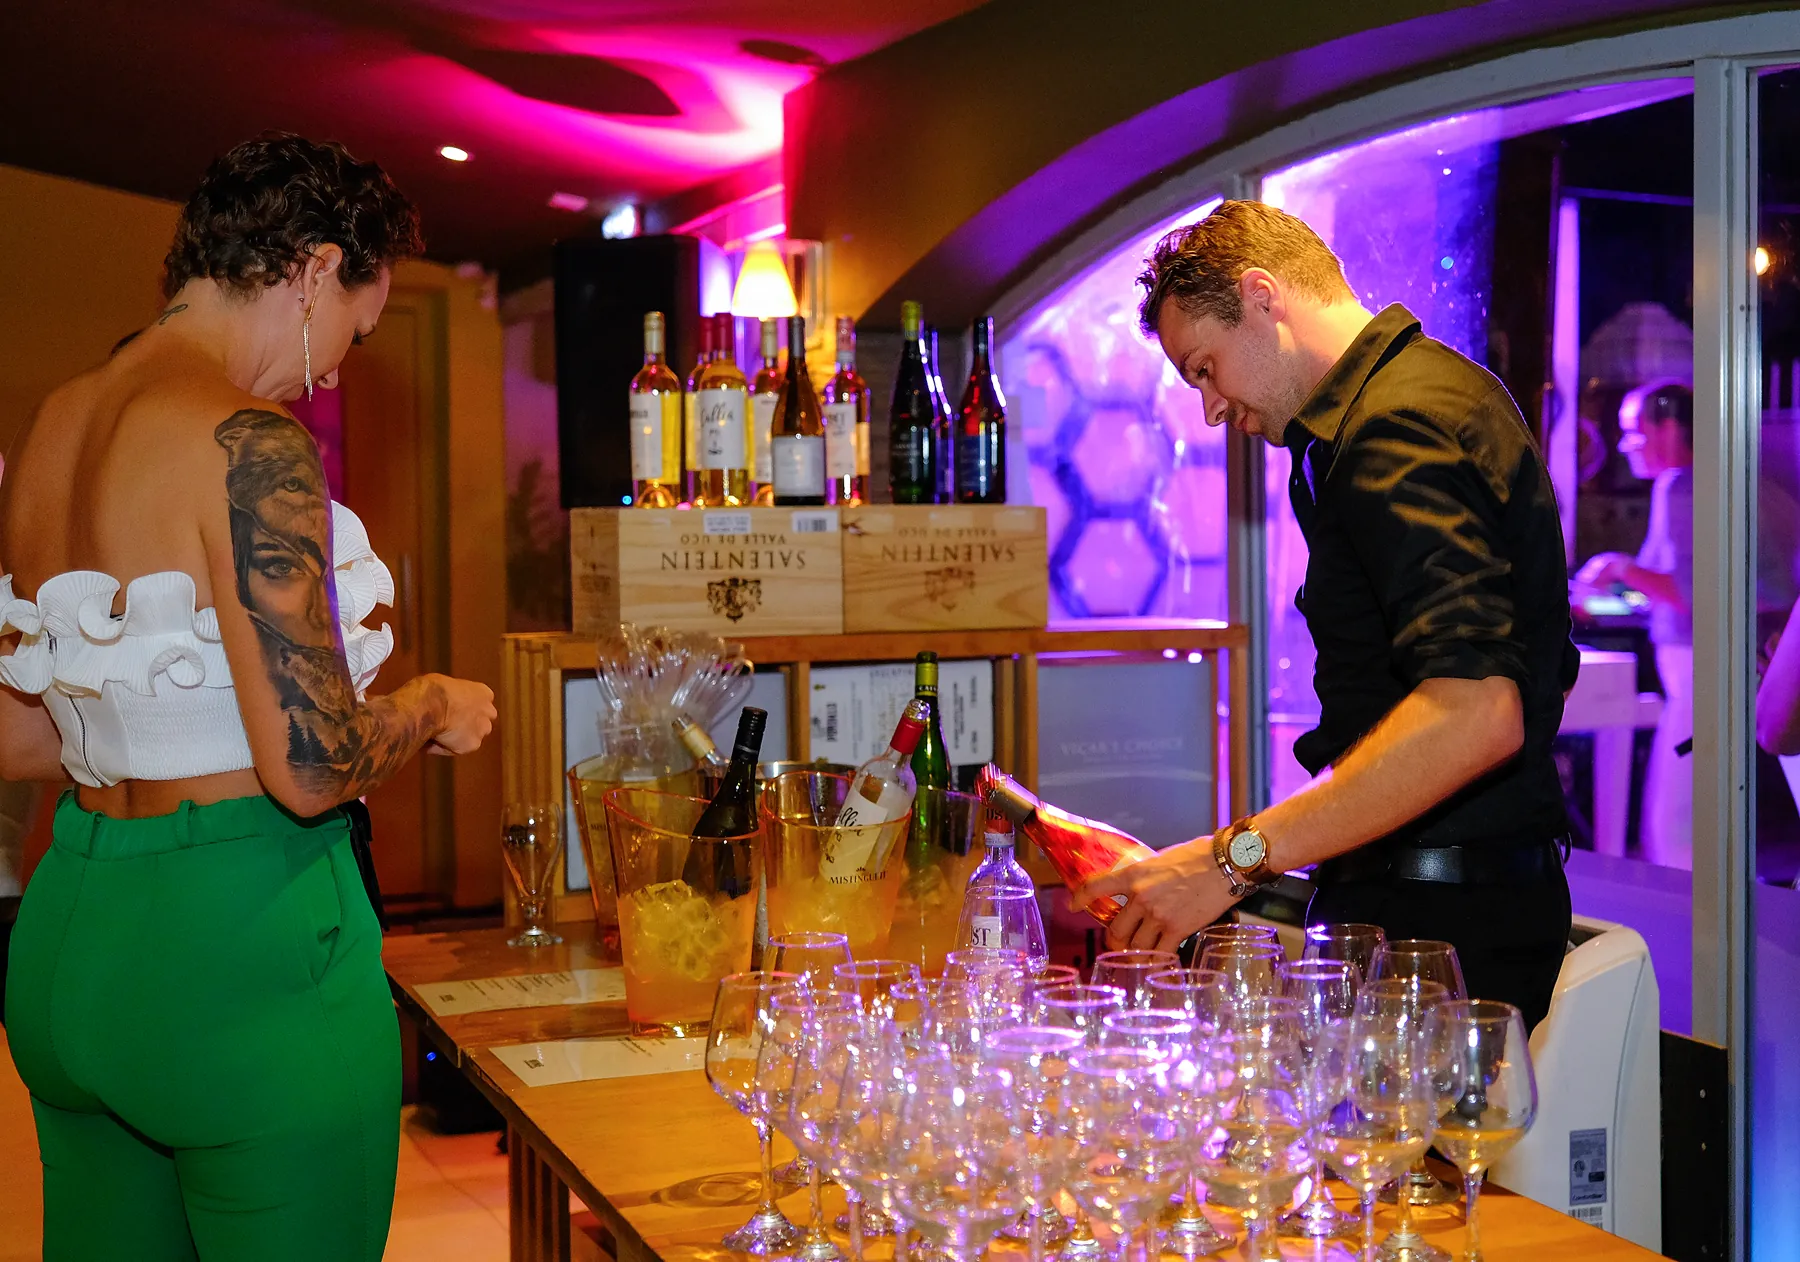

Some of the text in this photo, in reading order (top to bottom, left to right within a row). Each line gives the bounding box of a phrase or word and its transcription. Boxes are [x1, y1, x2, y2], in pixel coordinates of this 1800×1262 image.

[680, 534, 786, 545] VALLE DE UCO
[661, 551, 806, 571] SALENTEIN
